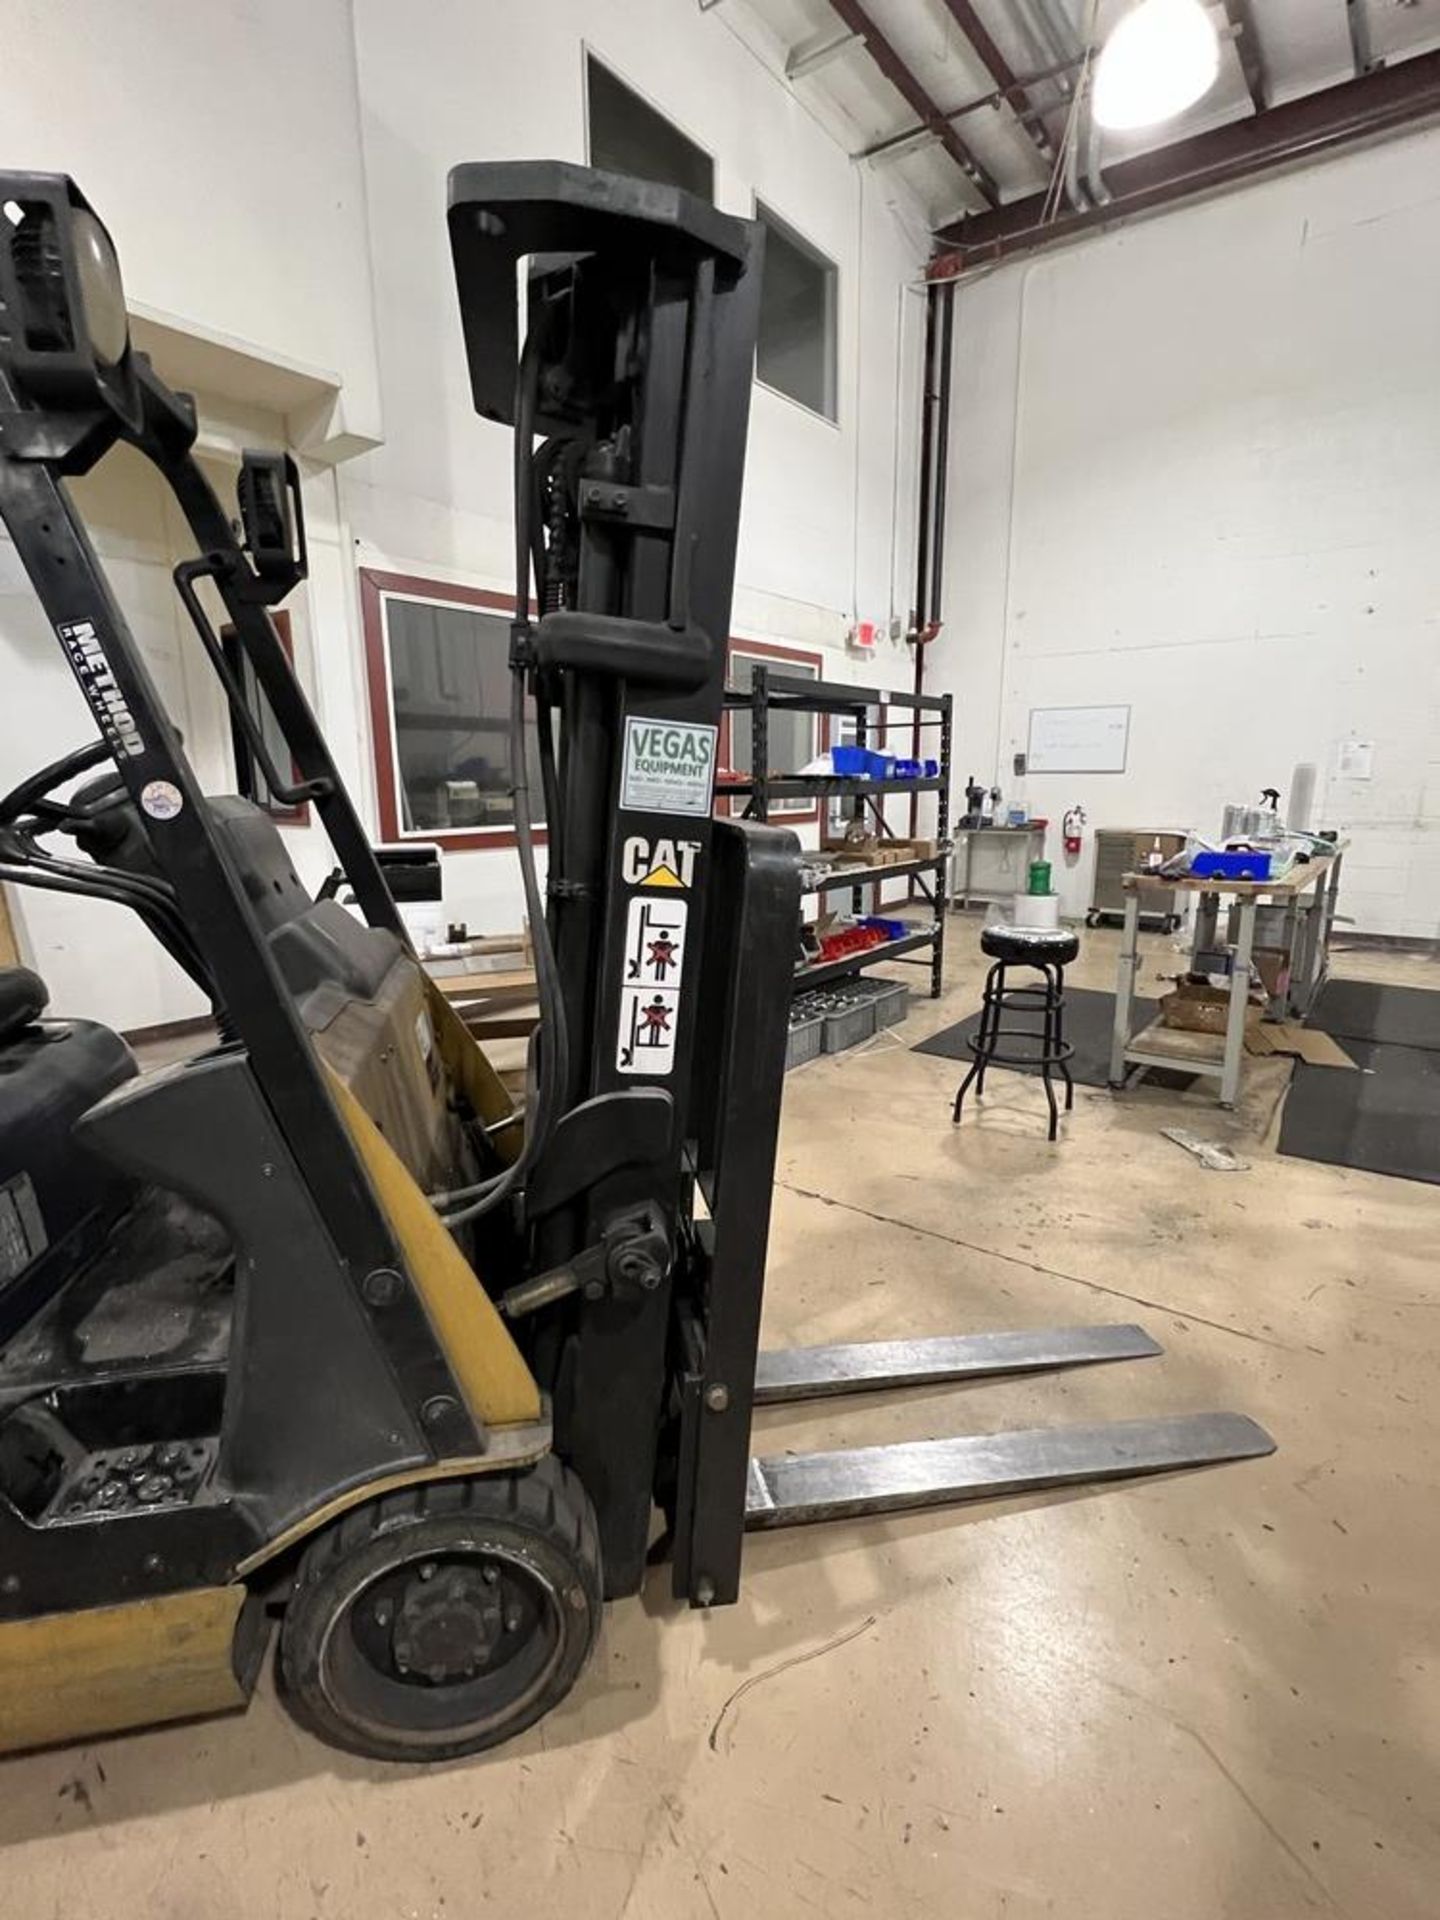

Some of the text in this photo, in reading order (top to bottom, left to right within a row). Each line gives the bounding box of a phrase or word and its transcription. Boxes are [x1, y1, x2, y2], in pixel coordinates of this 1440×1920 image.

[62, 627, 128, 760] RACE WHEELS
[72, 622, 145, 756] METHOD
[632, 728, 710, 765] VEGAS
[635, 758, 705, 779] EQUIPMENT
[621, 835, 702, 888] CAT
